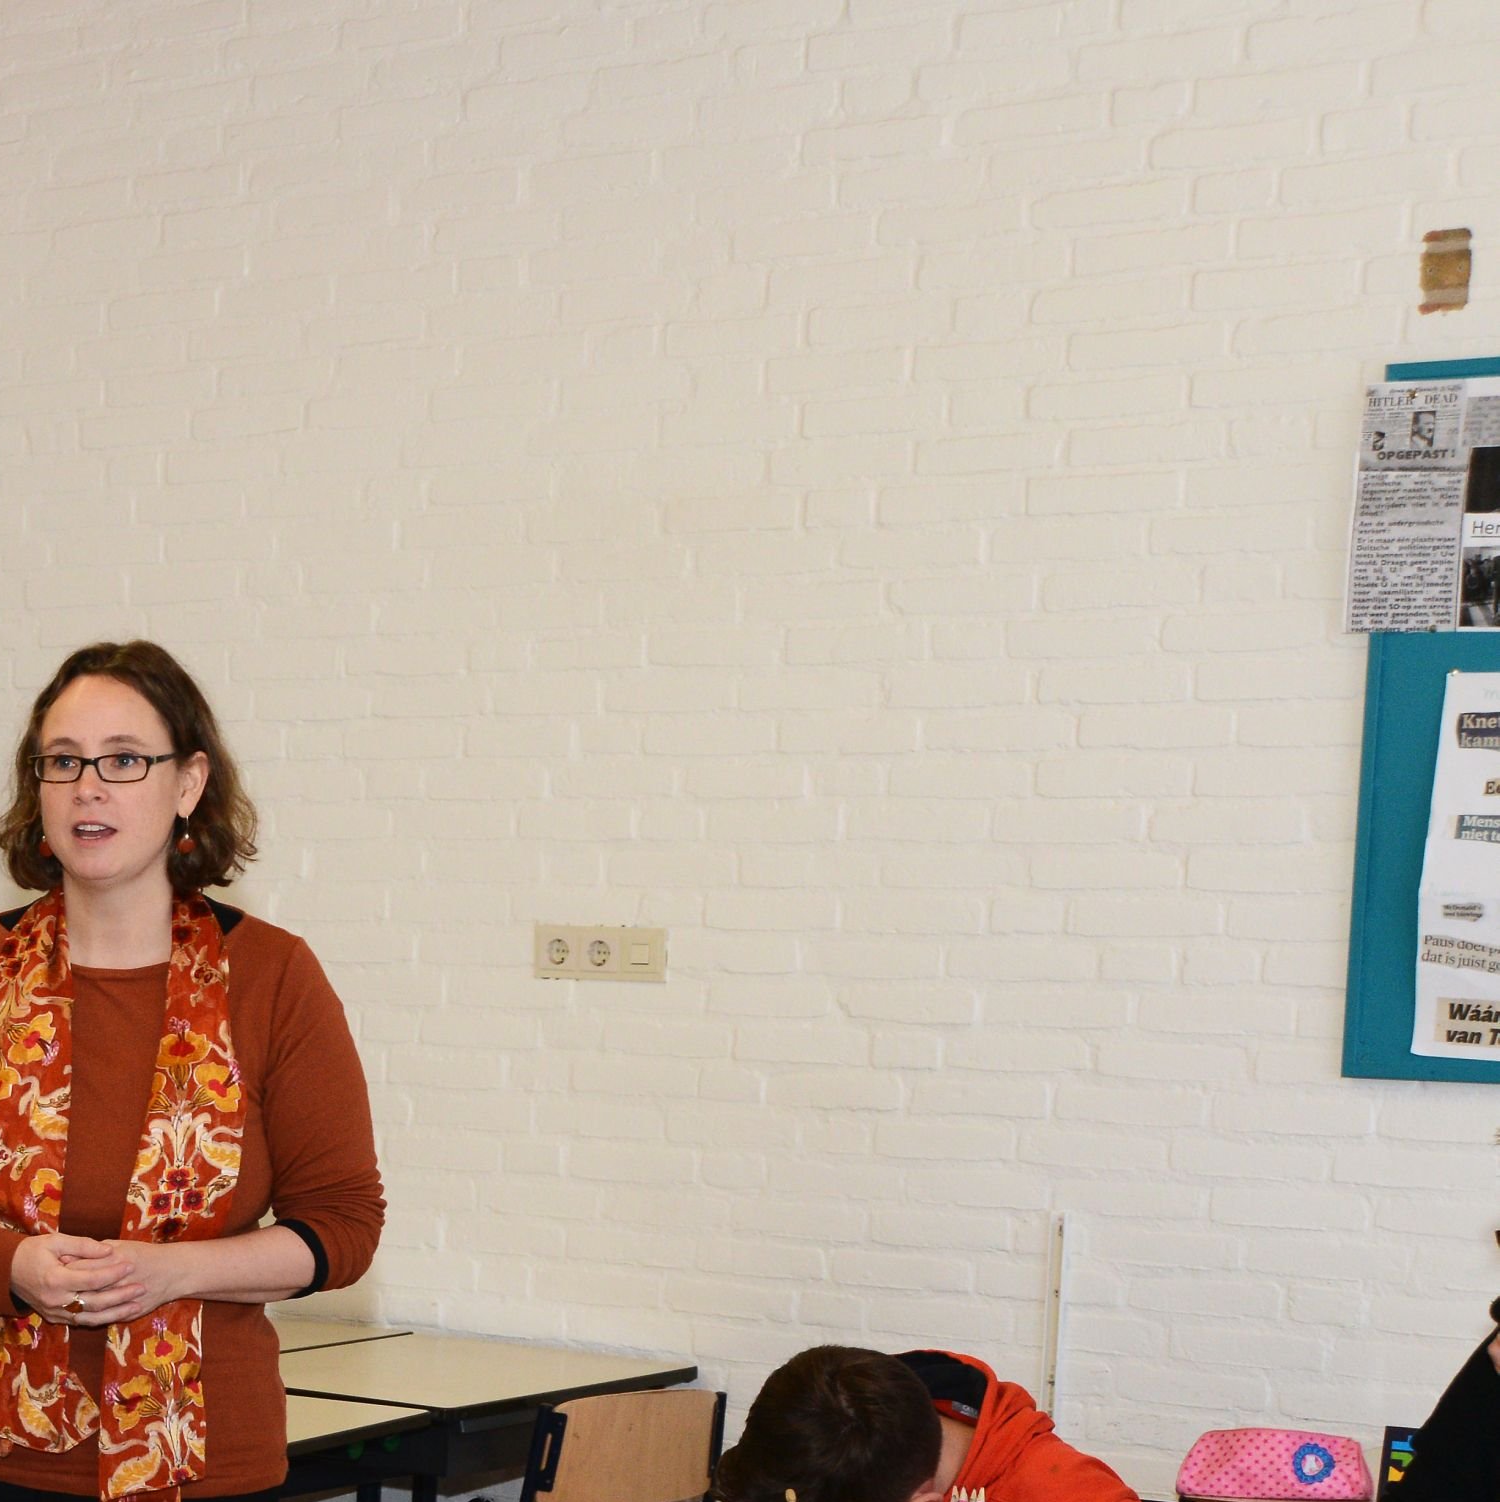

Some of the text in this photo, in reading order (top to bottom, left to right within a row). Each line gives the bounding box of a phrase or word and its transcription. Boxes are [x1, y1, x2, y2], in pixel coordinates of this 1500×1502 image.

[1368, 393, 1458, 407] HITLER DEAD
[1461, 830, 1489, 841] niet
[1424, 934, 1454, 948] Paus
[1421, 950, 1486, 969] dat is juist
[1446, 1029, 1482, 1044] van
